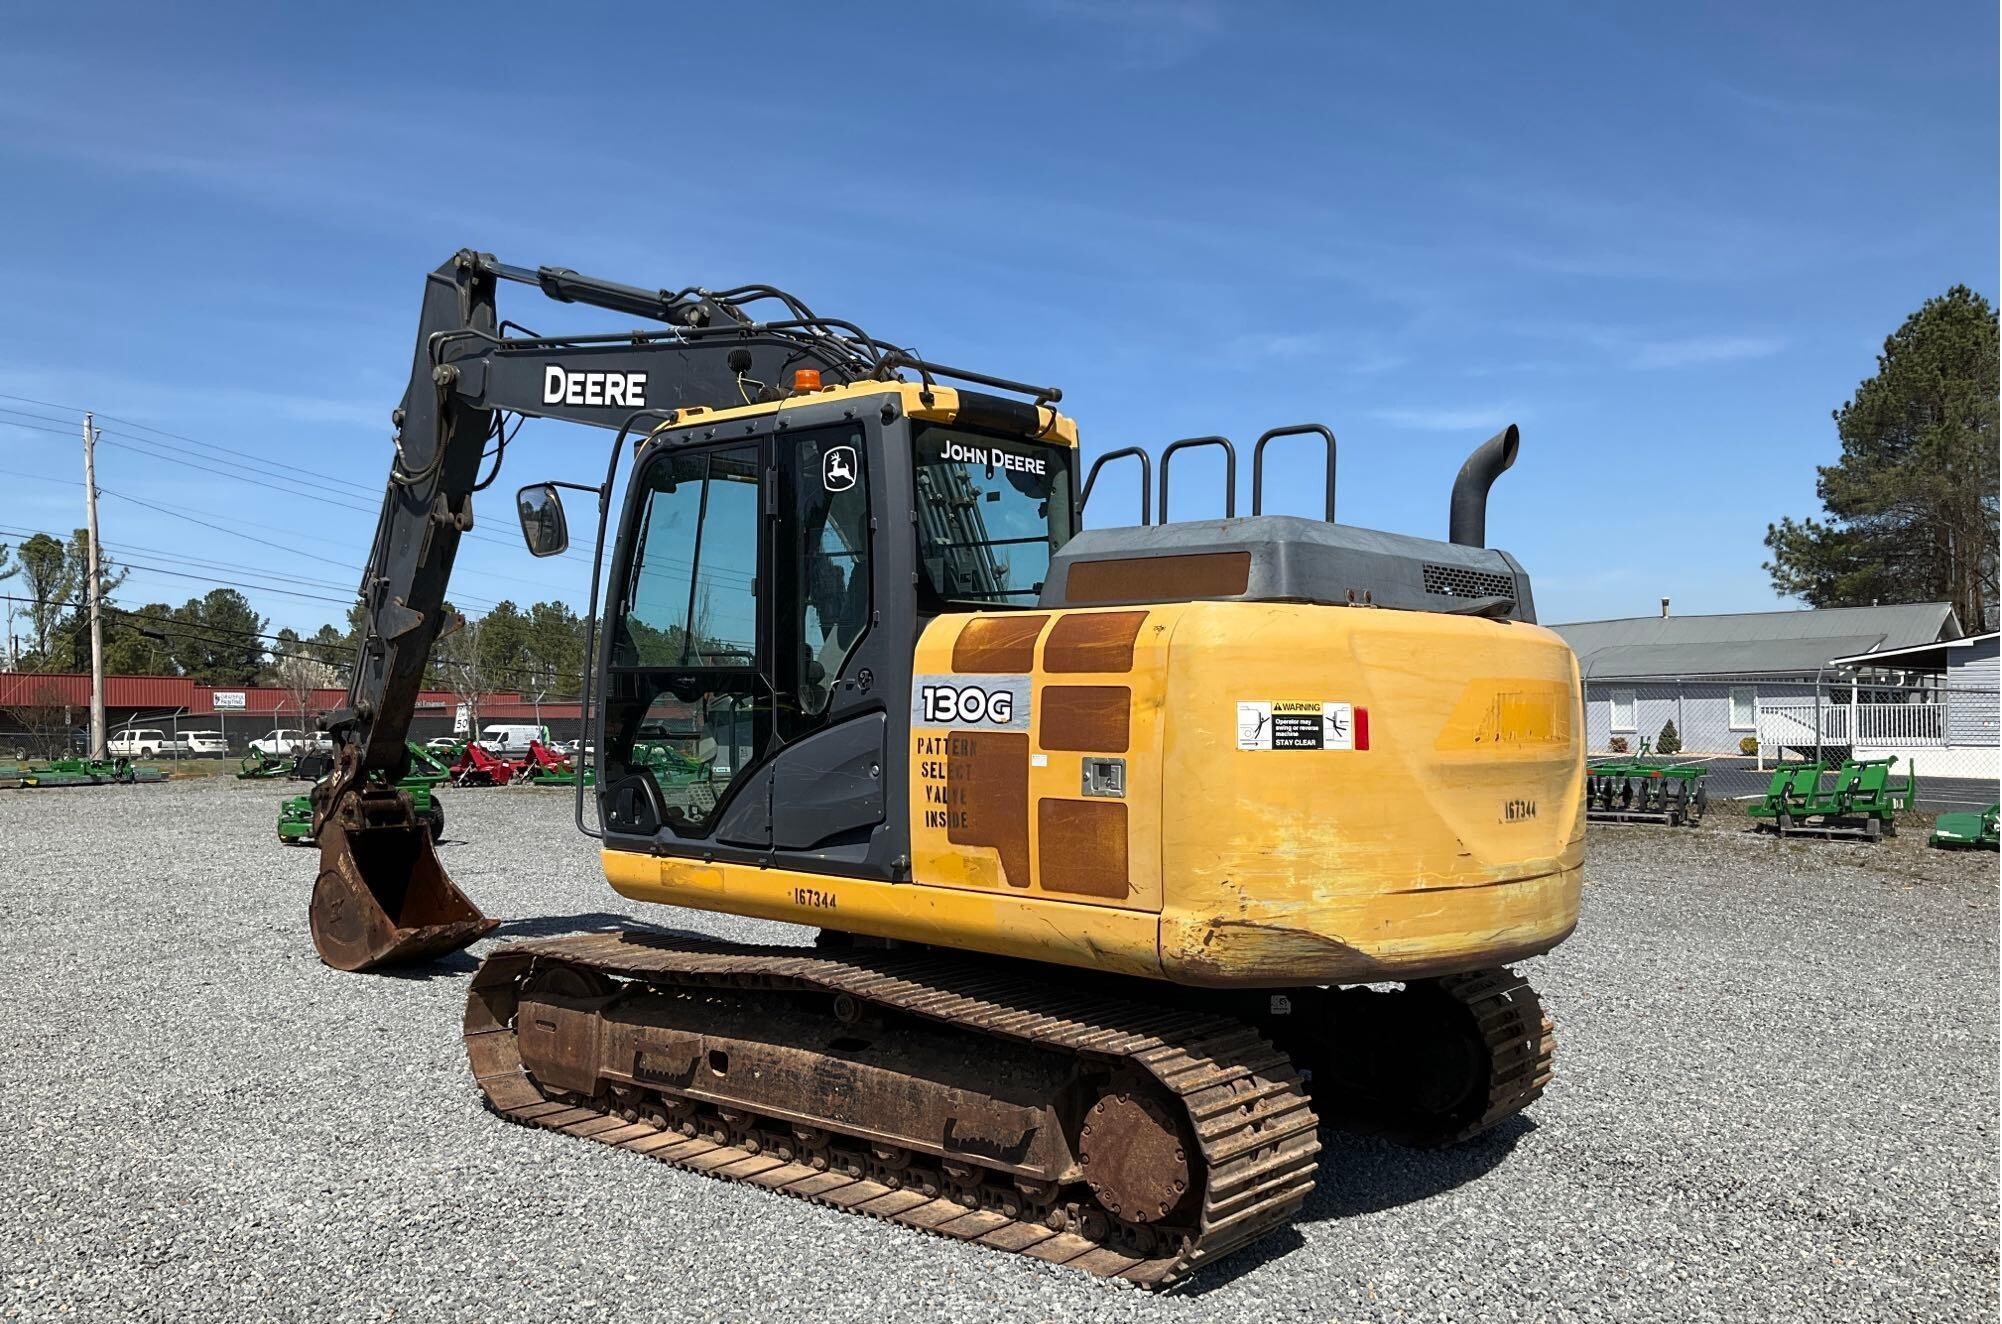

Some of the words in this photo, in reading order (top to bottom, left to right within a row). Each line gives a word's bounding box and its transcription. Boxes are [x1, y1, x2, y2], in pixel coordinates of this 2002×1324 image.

[543, 365, 647, 407] DEERE
[940, 440, 988, 465] JOHN
[991, 448, 1046, 475] DEERE
[922, 685, 1013, 724] 130G
[1282, 703, 1320, 711] WARNING
[456, 718, 469, 729] 50
[917, 737, 977, 757] PATTERN
[921, 761, 972, 781] SELECT
[926, 785, 968, 805] VALVE
[925, 810, 969, 829] INSIDE
[1505, 799, 1536, 820] 167344
[794, 887, 837, 909] 167344
